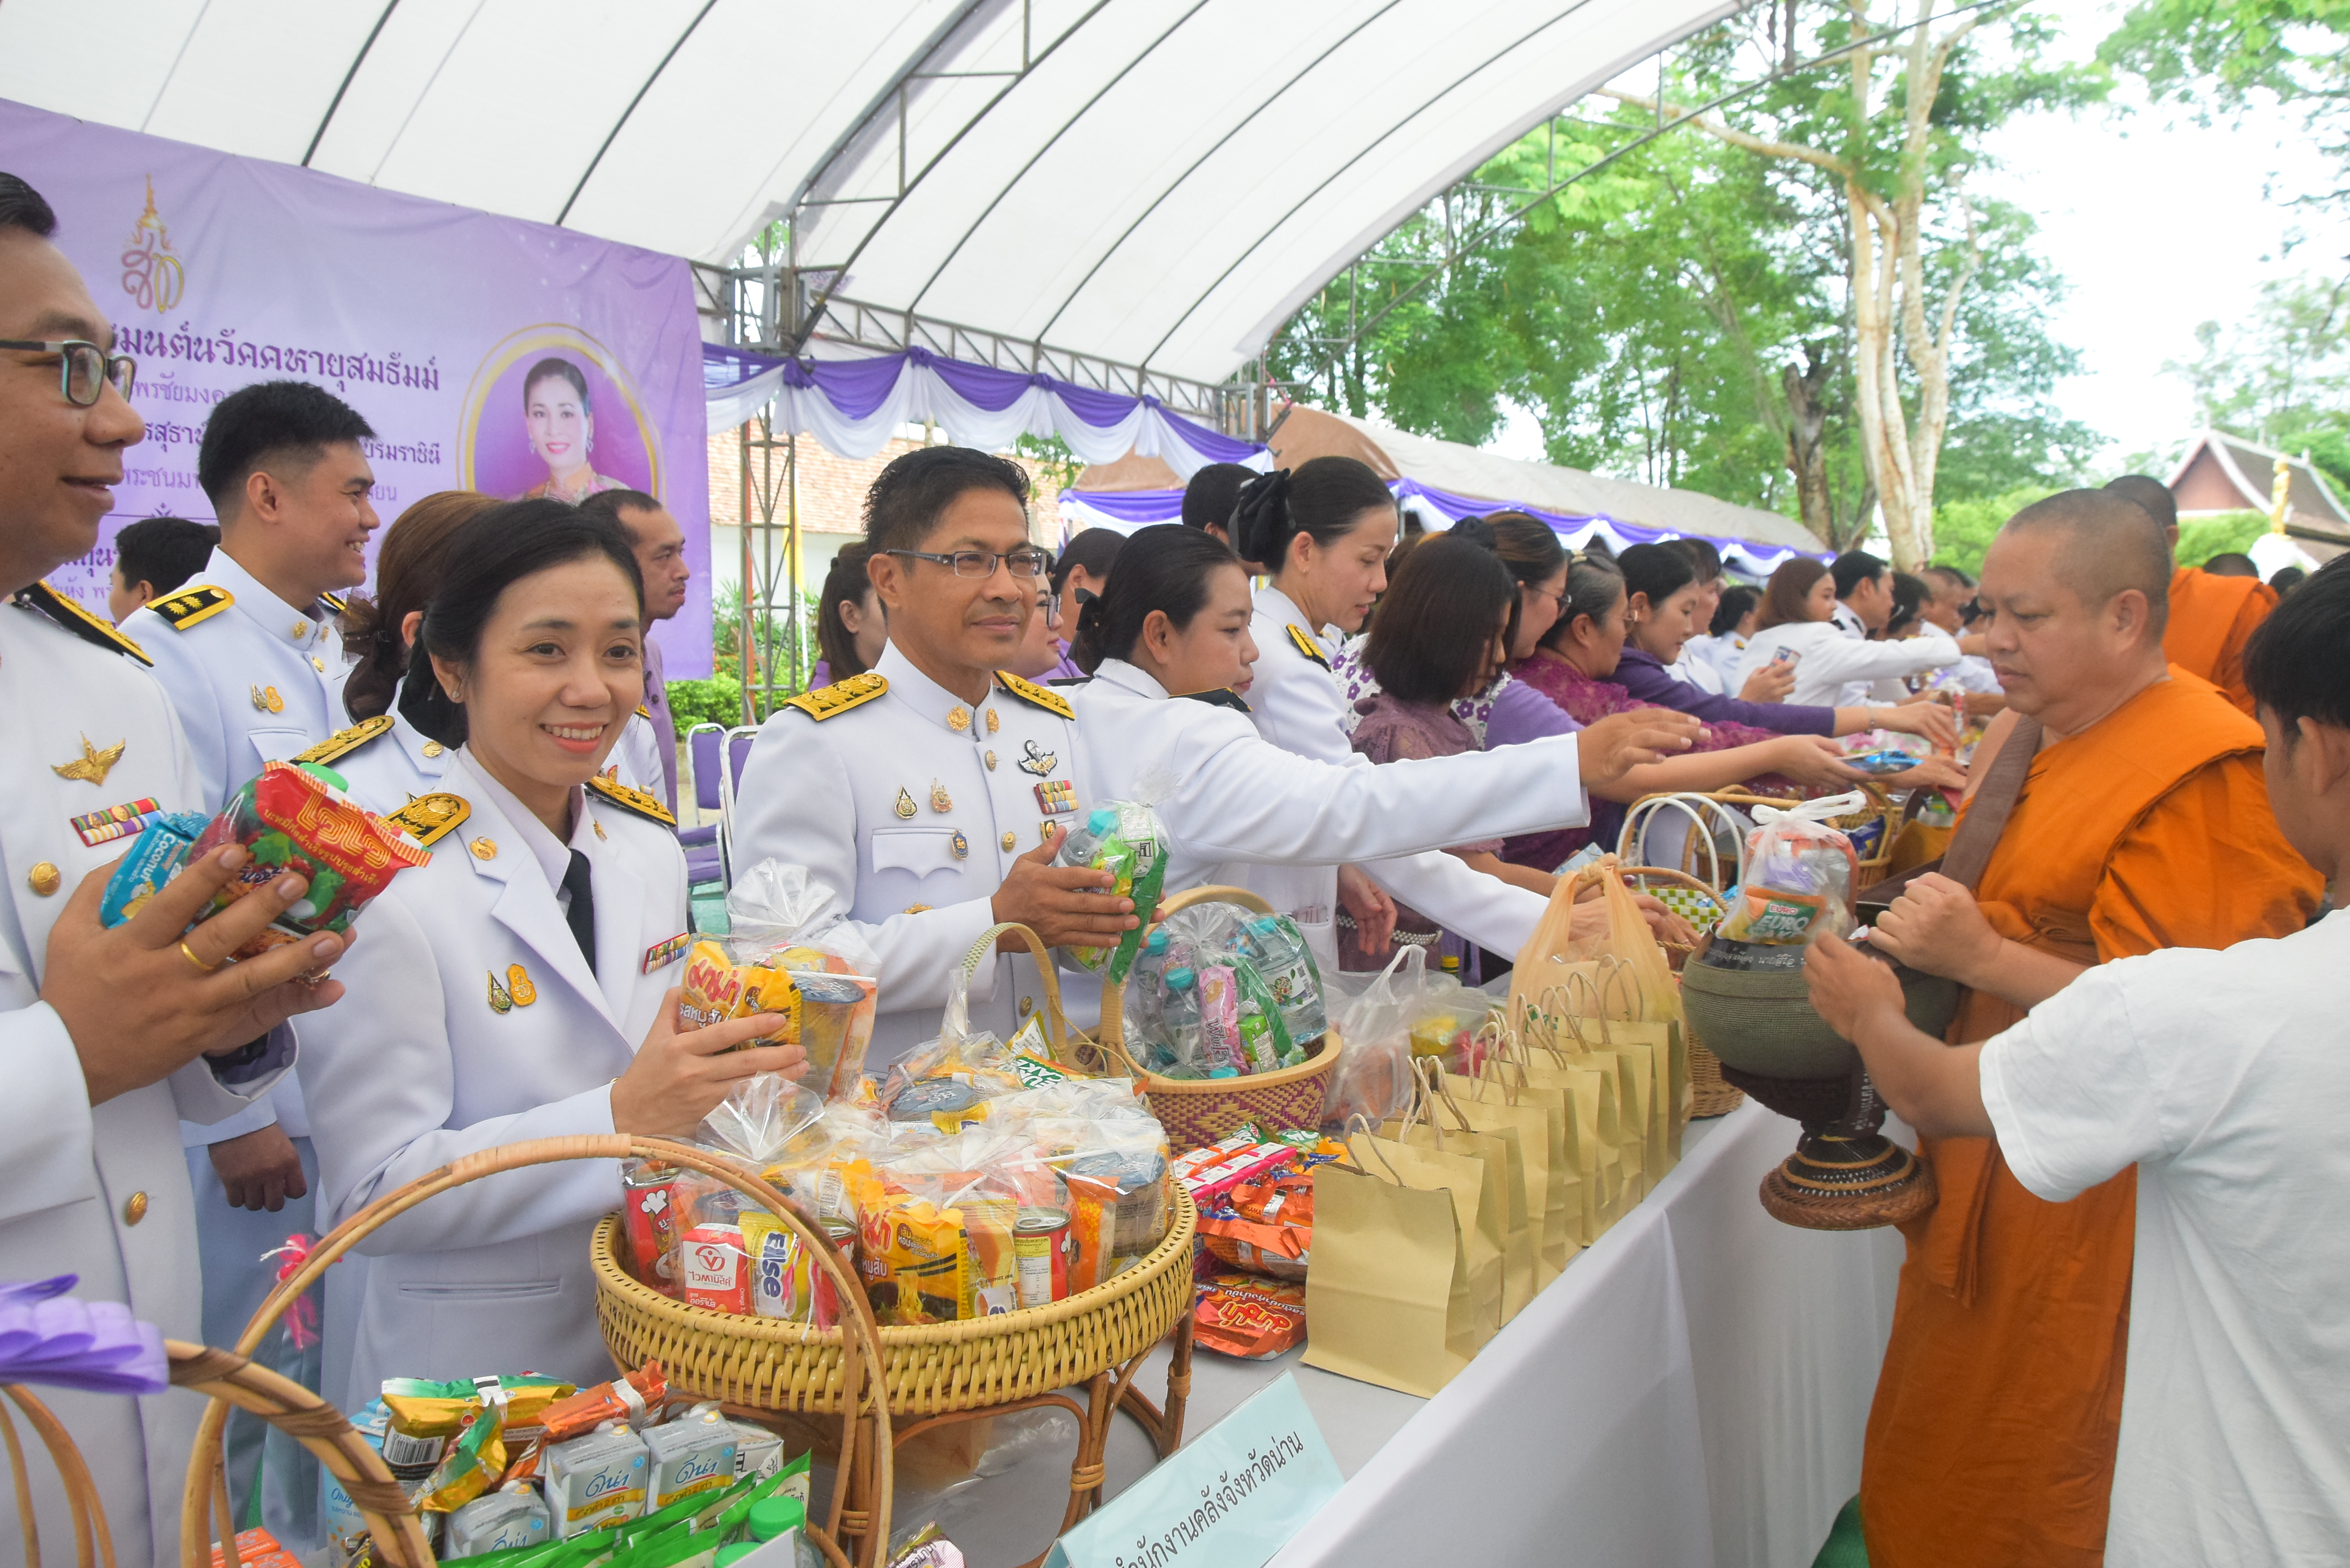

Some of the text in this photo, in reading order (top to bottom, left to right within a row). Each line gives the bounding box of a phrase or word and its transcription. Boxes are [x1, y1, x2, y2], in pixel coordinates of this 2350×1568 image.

[133, 371, 233, 406] พรชัยมงค
[140, 833, 176, 883] Coconut
[1769, 904, 1799, 915] EURO
[585, 1465, 630, 1498] ดีน่า
[675, 1454, 719, 1484] ดีน่า
[1115, 1431, 1304, 1568] ำนักงานคลังจังหวัดน่าน
